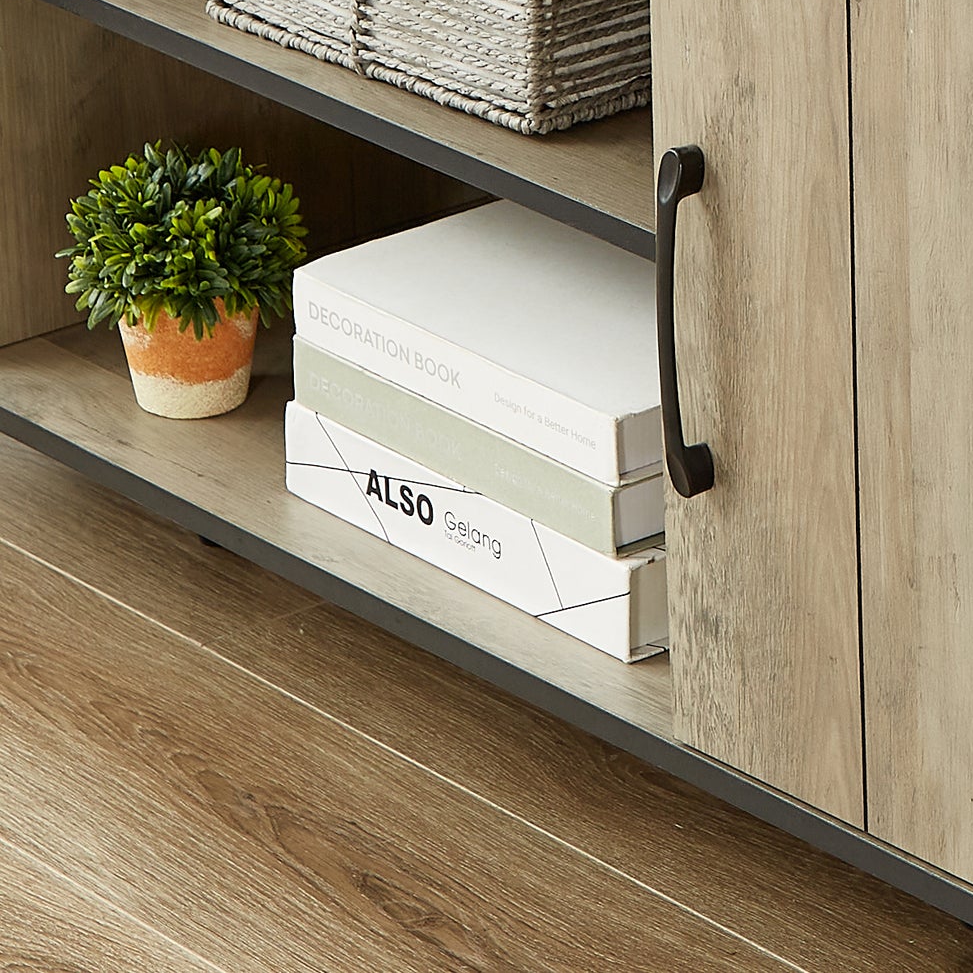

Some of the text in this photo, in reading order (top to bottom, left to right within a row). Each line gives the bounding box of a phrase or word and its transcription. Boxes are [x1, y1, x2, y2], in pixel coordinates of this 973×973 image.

[308, 301, 461, 389] DECORATION BOOK
[307, 370, 463, 460] DECORATION BOOK
[494, 391, 522, 414] Design
[523, 405, 536, 420] for
[544, 415, 569, 436] Better
[571, 428, 597, 450] Home
[366, 468, 434, 526] ALSO
[444, 511, 501, 560] Gelang
